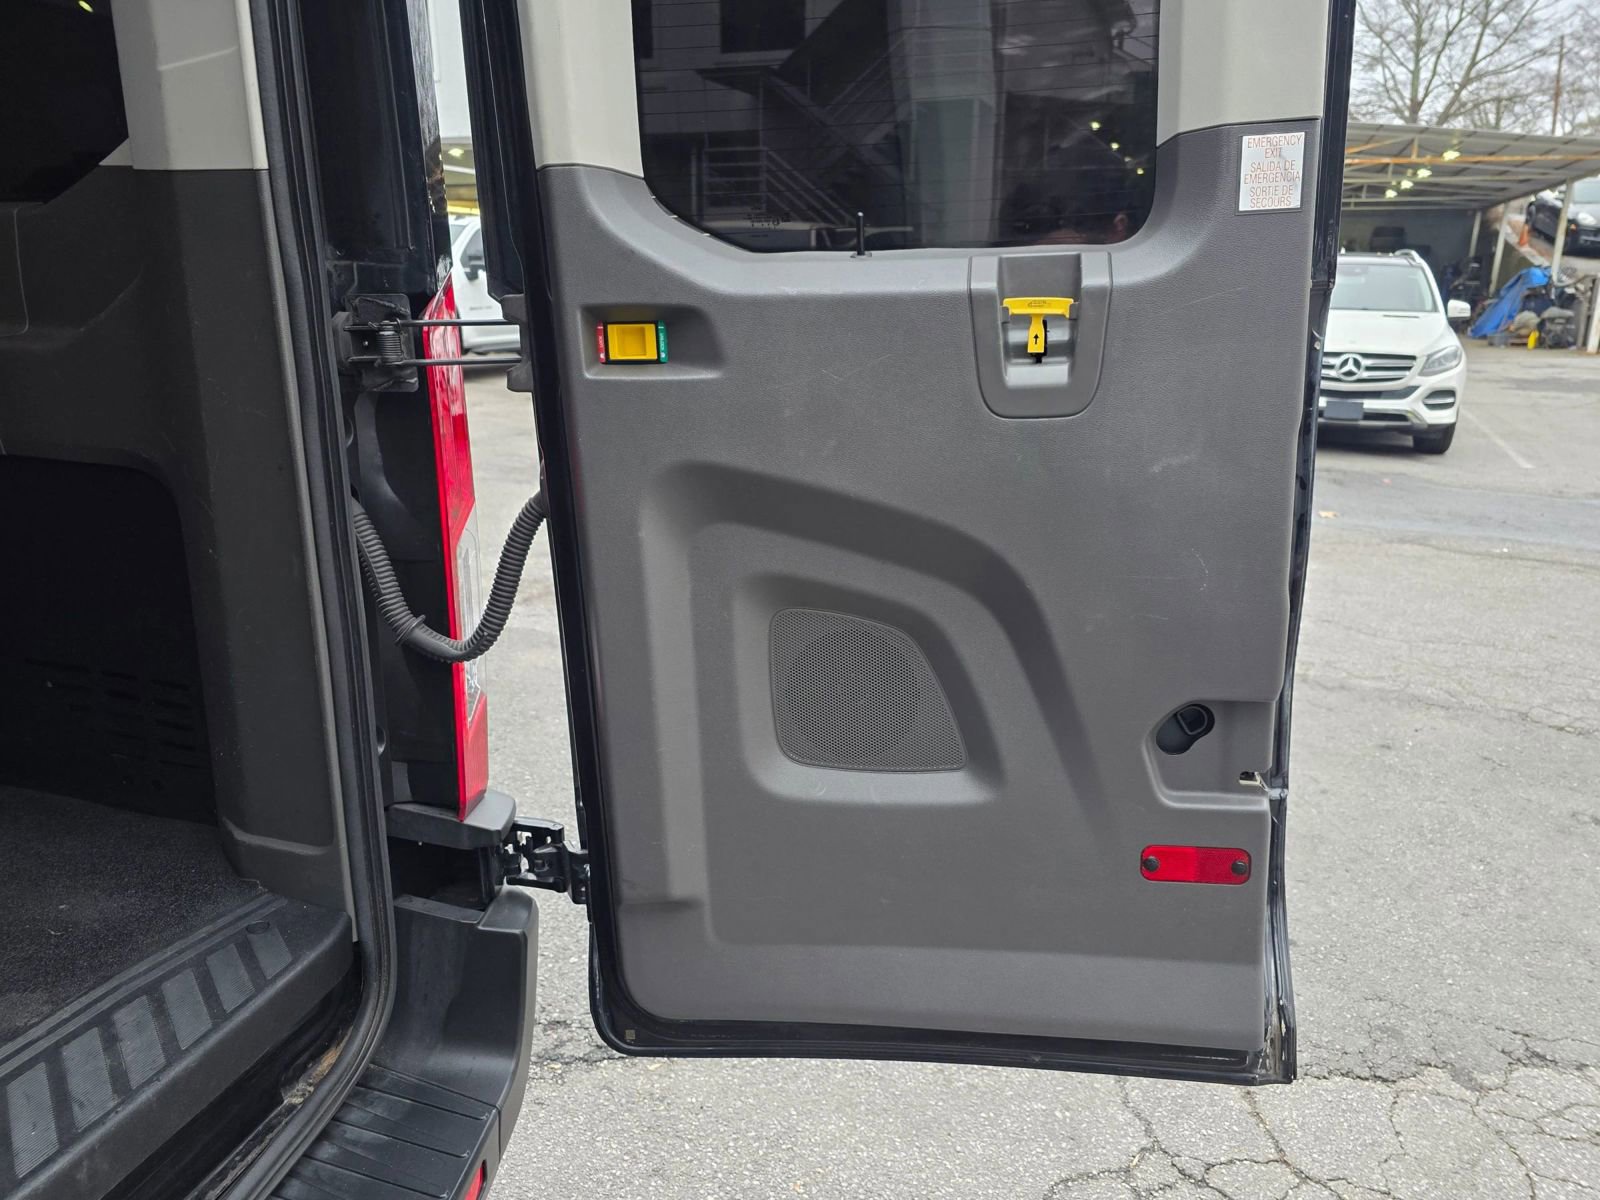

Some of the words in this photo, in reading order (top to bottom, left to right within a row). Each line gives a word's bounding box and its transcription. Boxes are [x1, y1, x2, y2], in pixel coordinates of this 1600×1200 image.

[1247, 135, 1303, 148] EMERGENCY
[1264, 148, 1282, 158] EXIT
[1250, 161, 1281, 172] SALIDA
[1283, 160, 1296, 171] DE
[1244, 171, 1300, 184] EMERGENCIA
[1249, 185, 1280, 197] SORTIE
[1281, 185, 1294, 196] DE
[1249, 197, 1291, 208] SECOURS
